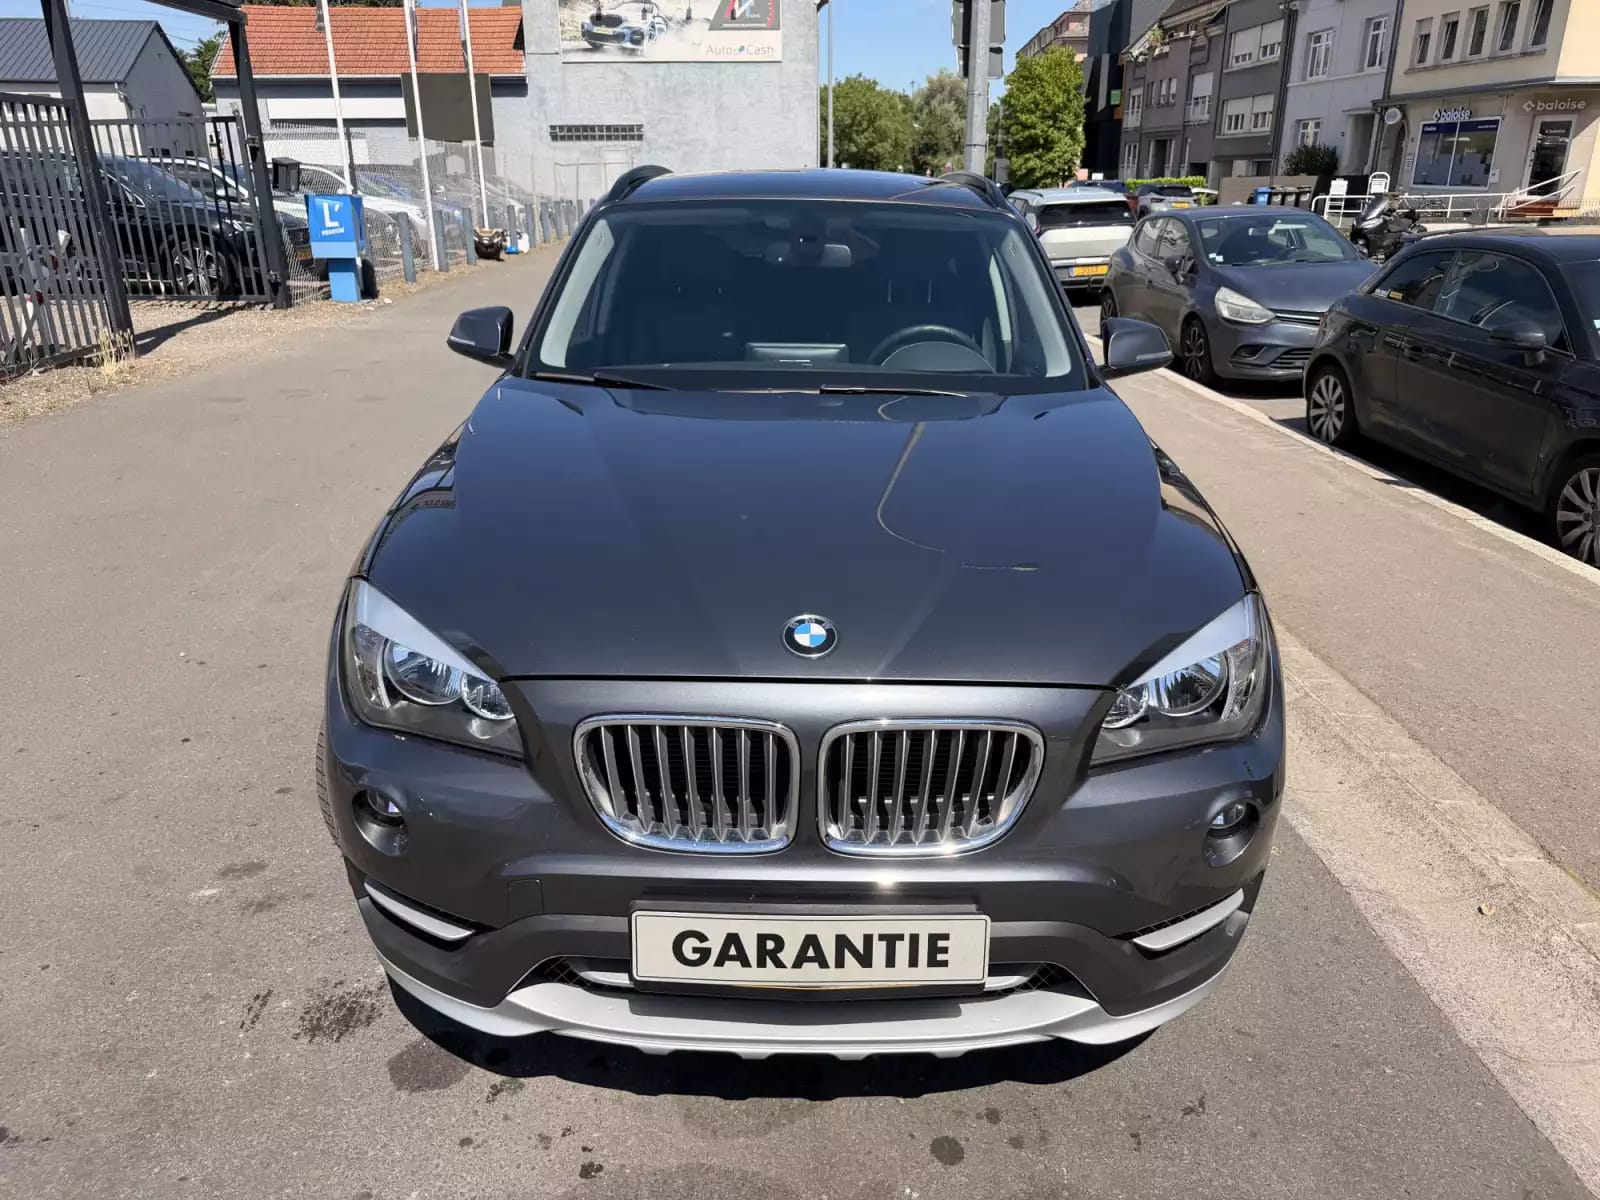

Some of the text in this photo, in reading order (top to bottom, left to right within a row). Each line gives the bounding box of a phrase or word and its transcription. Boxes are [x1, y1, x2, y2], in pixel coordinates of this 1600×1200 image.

[745, 44, 774, 56] Cash
[1536, 98, 1586, 111] baloise
[1441, 106, 1471, 121] baloise
[672, 929, 951, 969] GARANTIE
